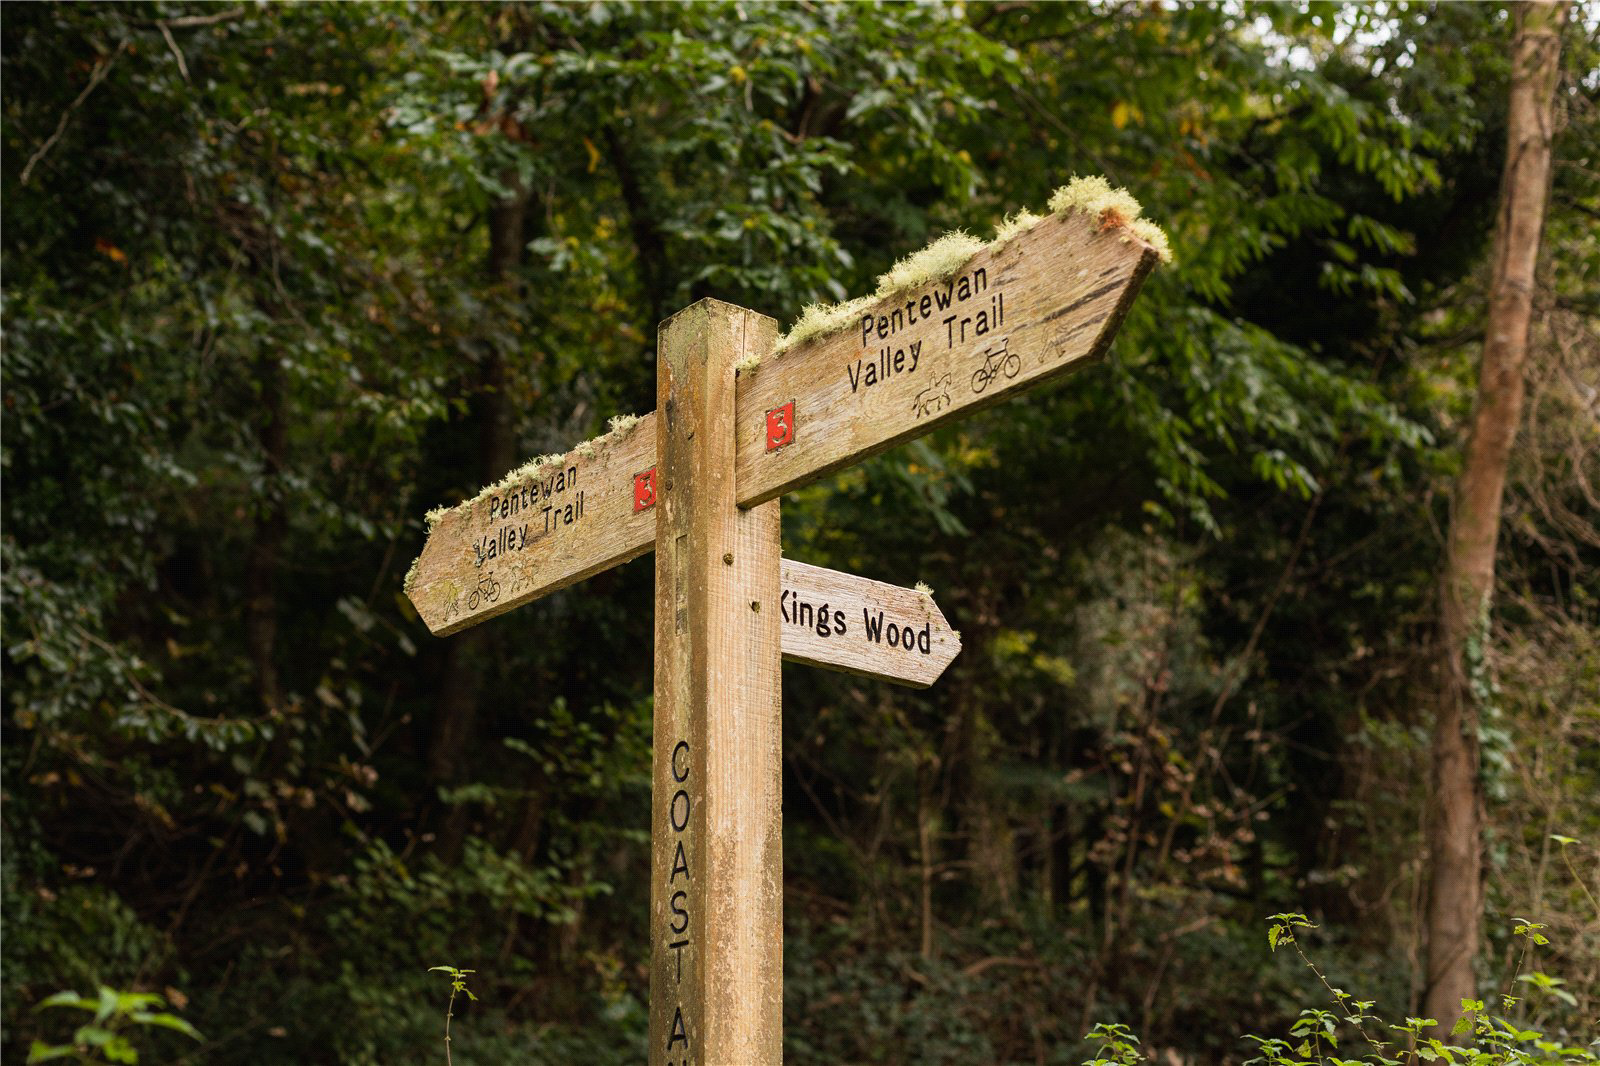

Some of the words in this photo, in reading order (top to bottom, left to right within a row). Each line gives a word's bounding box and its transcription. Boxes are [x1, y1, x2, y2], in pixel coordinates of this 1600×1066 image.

[862, 267, 987, 348] Pentewan
[847, 339, 922, 394] Valley
[942, 293, 1004, 349] Trail
[772, 409, 788, 444] 3
[489, 466, 577, 524] Pentewan
[640, 474, 653, 506] 3
[472, 524, 529, 568] Valley
[542, 490, 584, 533] Trail
[863, 607, 931, 655] Wood
[668, 740, 691, 985] COAST
[667, 1006, 689, 1066] A
